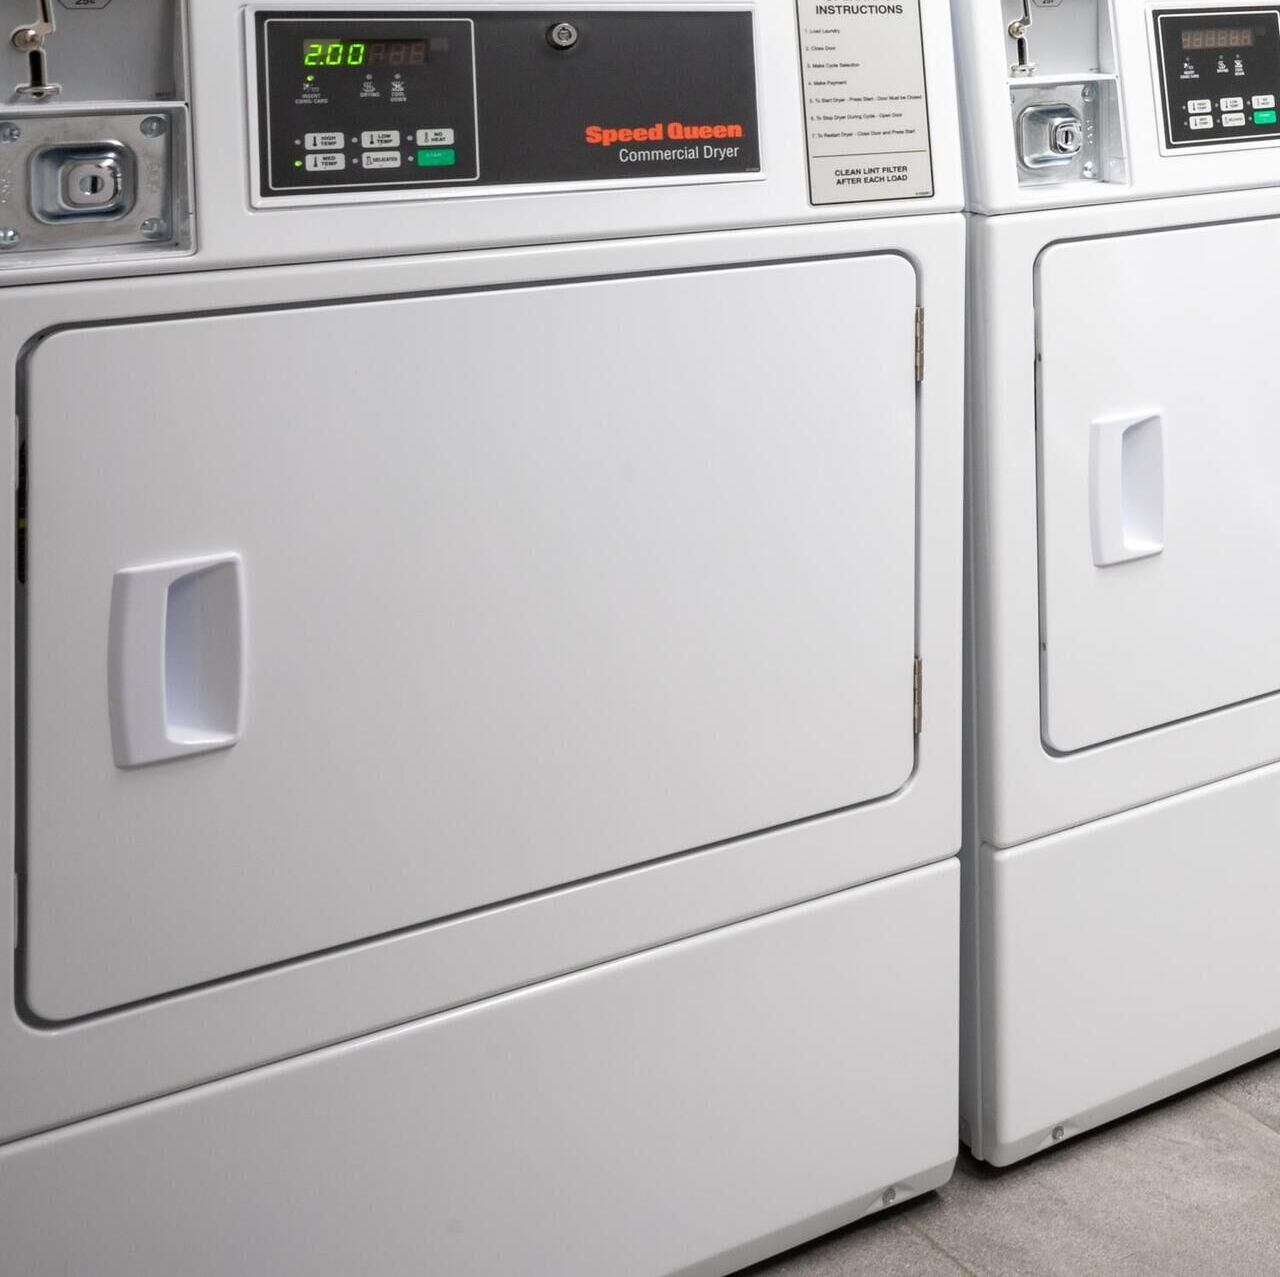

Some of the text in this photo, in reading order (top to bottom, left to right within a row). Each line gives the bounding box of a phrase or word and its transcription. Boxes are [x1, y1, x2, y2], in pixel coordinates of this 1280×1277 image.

[815, 4, 904, 15] INSTRUCTIONS
[304, 43, 365, 66] 2.00
[585, 122, 743, 147] Speed Queen
[619, 145, 740, 163] Commercial Dryer
[835, 165, 908, 177] CLEAN LINT FILTER
[836, 174, 908, 186] AFTER EACH LOAD
